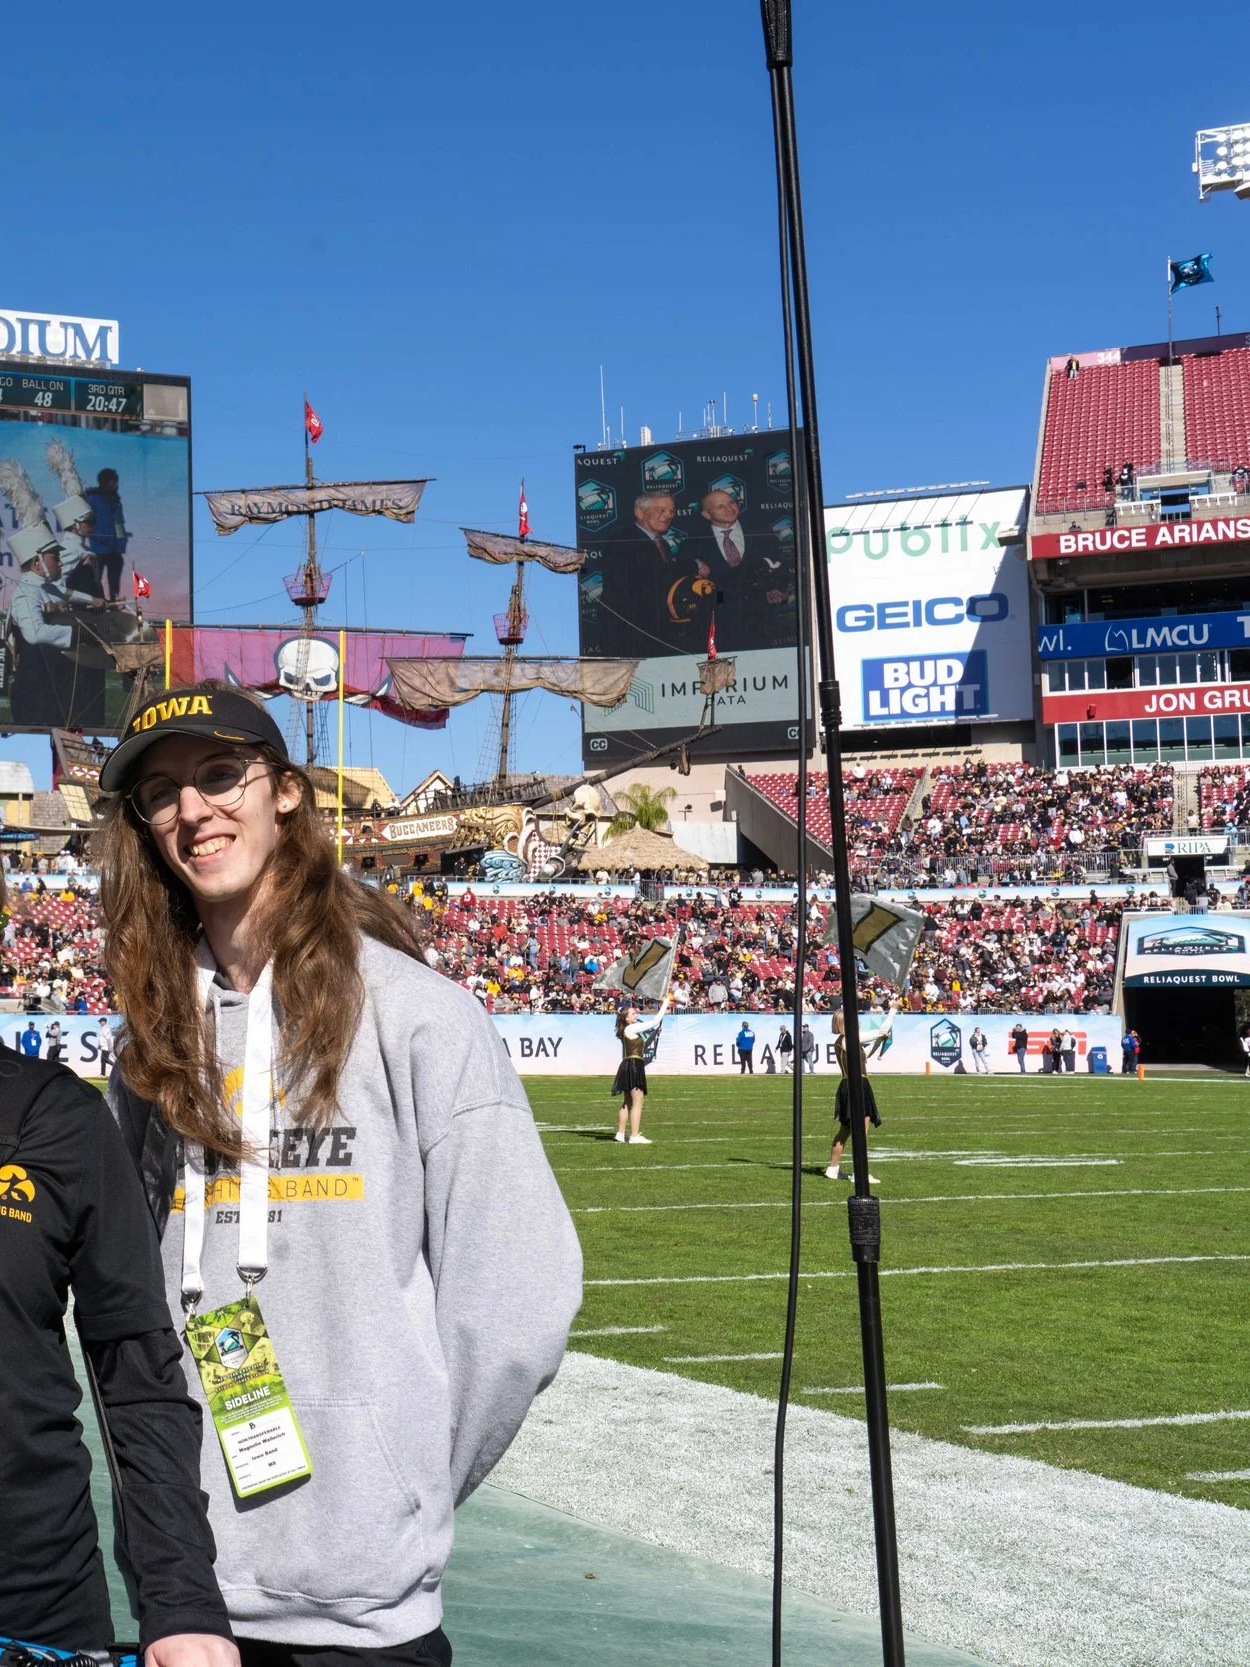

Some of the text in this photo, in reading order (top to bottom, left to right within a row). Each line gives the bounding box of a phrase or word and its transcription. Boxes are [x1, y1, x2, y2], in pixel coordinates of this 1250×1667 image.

[1097, 352, 1121, 363] 344
[0, 376, 13, 387] GO
[22, 378, 64, 392] BALL ON
[88, 384, 124, 396] 3RD QTR
[34, 391, 52, 408] 48
[86, 396, 126, 413] 20:47
[697, 454, 748, 463] RELIAQUEST
[1060, 518, 1250, 554] BRUCE ARIANS
[836, 592, 1009, 633] GEICO
[1132, 624, 1209, 649] LMCU
[883, 658, 964, 689] BUD
[868, 684, 980, 716] LIGHT
[1144, 692, 1196, 713] JON
[132, 695, 212, 733] IOWA
[590, 739, 608, 750] CC
[388, 816, 455, 839] BUCCANEERS
[1177, 842, 1212, 854] RIPA
[1144, 975, 1240, 984] RELIAQUEST BOWL
[520, 1037, 563, 1058] BAY
[286, 1178, 348, 1198] BAND
[8, 1207, 32, 1223] BAND
[224, 1386, 271, 1411] SIDELINE
[249, 1422, 256, 1430] B
[252, 1446, 278, 1461] Iowa Band
